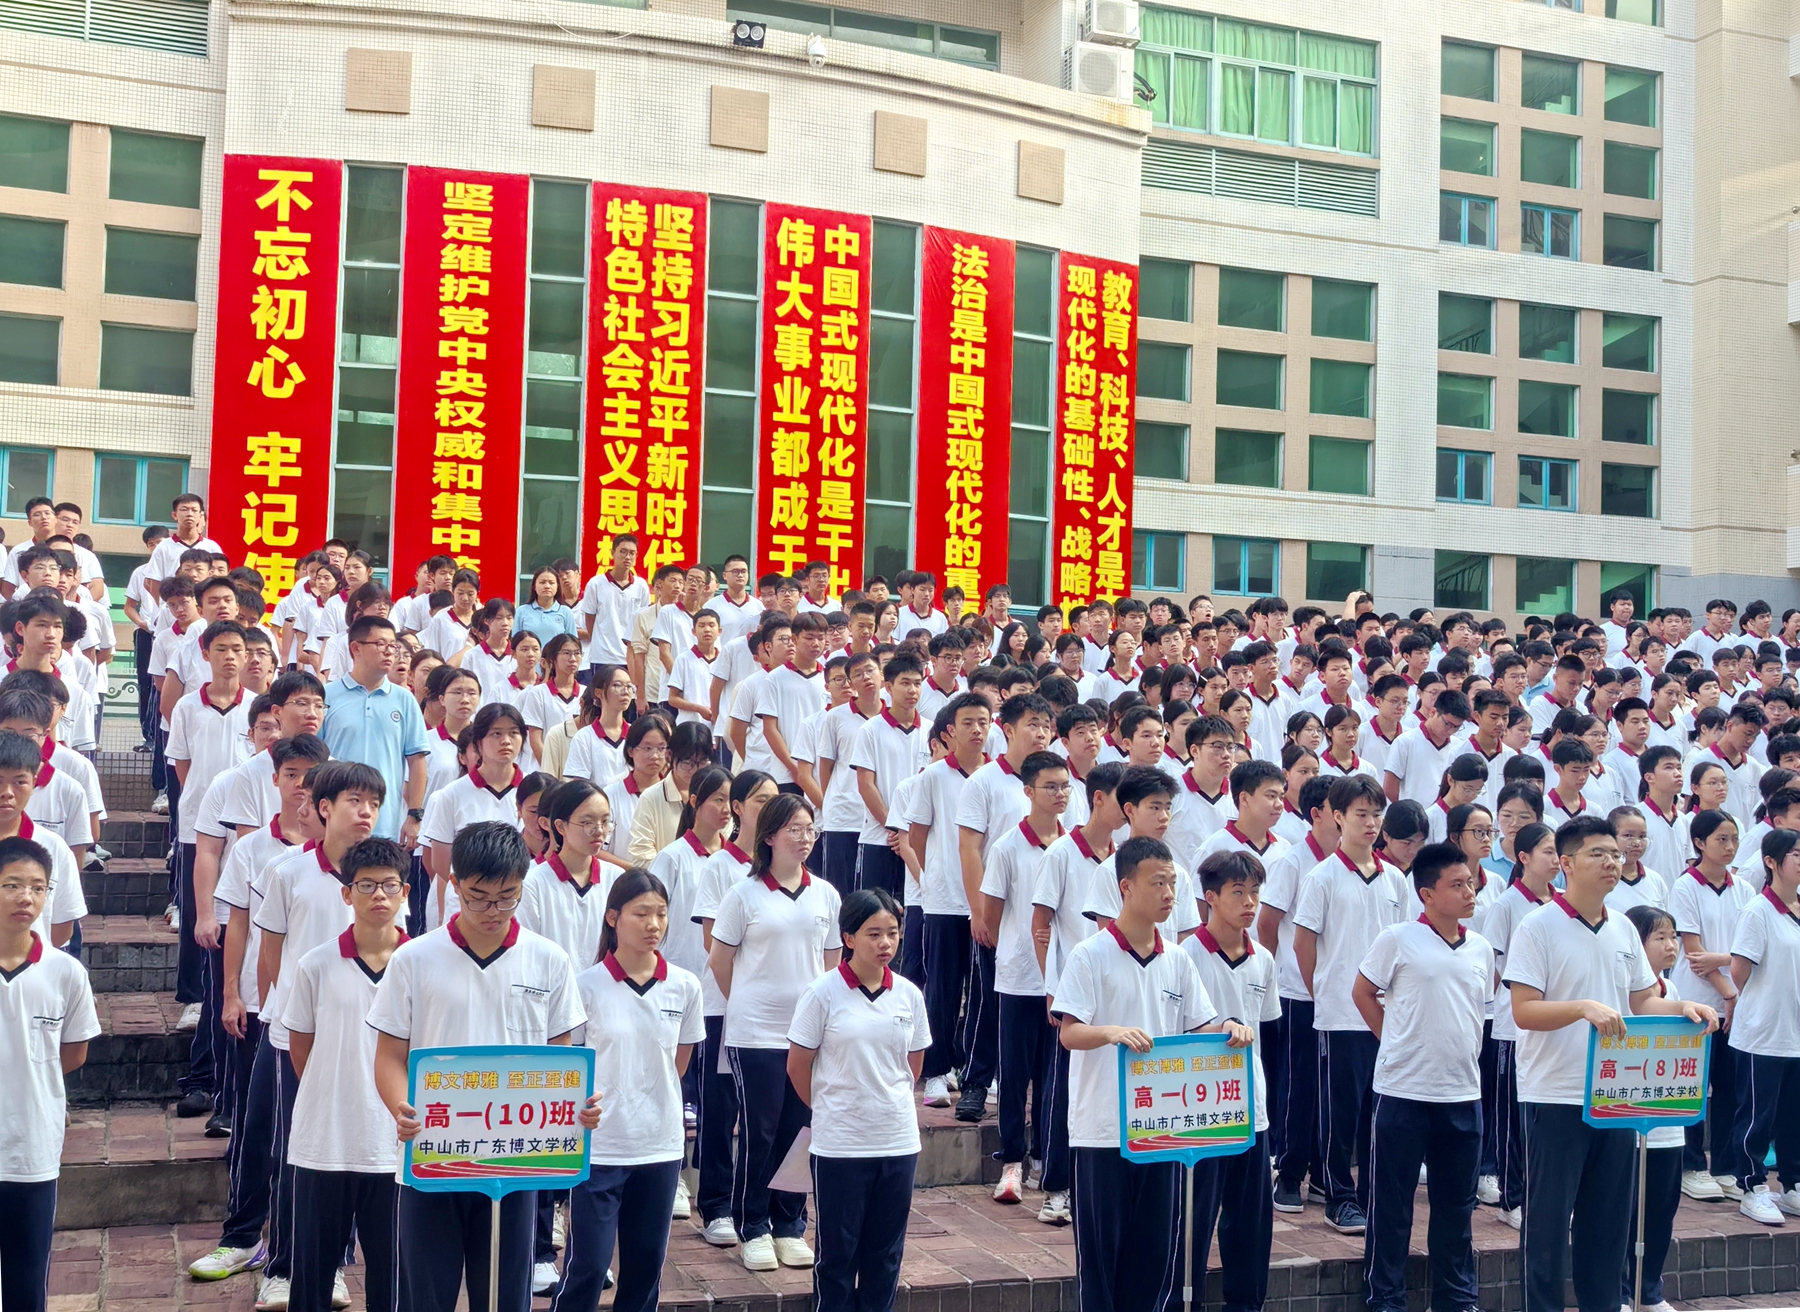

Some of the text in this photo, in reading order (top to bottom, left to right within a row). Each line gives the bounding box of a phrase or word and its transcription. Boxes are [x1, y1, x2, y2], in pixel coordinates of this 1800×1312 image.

[241, 169, 313, 630] 不忘初心 牢记使
[642, 203, 695, 603] 坚持习近平新时代
[768, 216, 815, 578] 伟大事业都成于
[1130, 1053, 1243, 1076] 博文博雅 至正至健
[1600, 1057, 1698, 1080] 高一(8)班
[423, 1070, 581, 1090] 博文博雅 至正至健
[1134, 1079, 1241, 1109] 高一(9)班
[1595, 1086, 1699, 1099] 中山市广东博文学校
[424, 1100, 576, 1130] 高一(10)班
[1131, 1110, 1245, 1132] 中山市广东博文学校
[419, 1137, 578, 1155] 中山市广东博文学校
